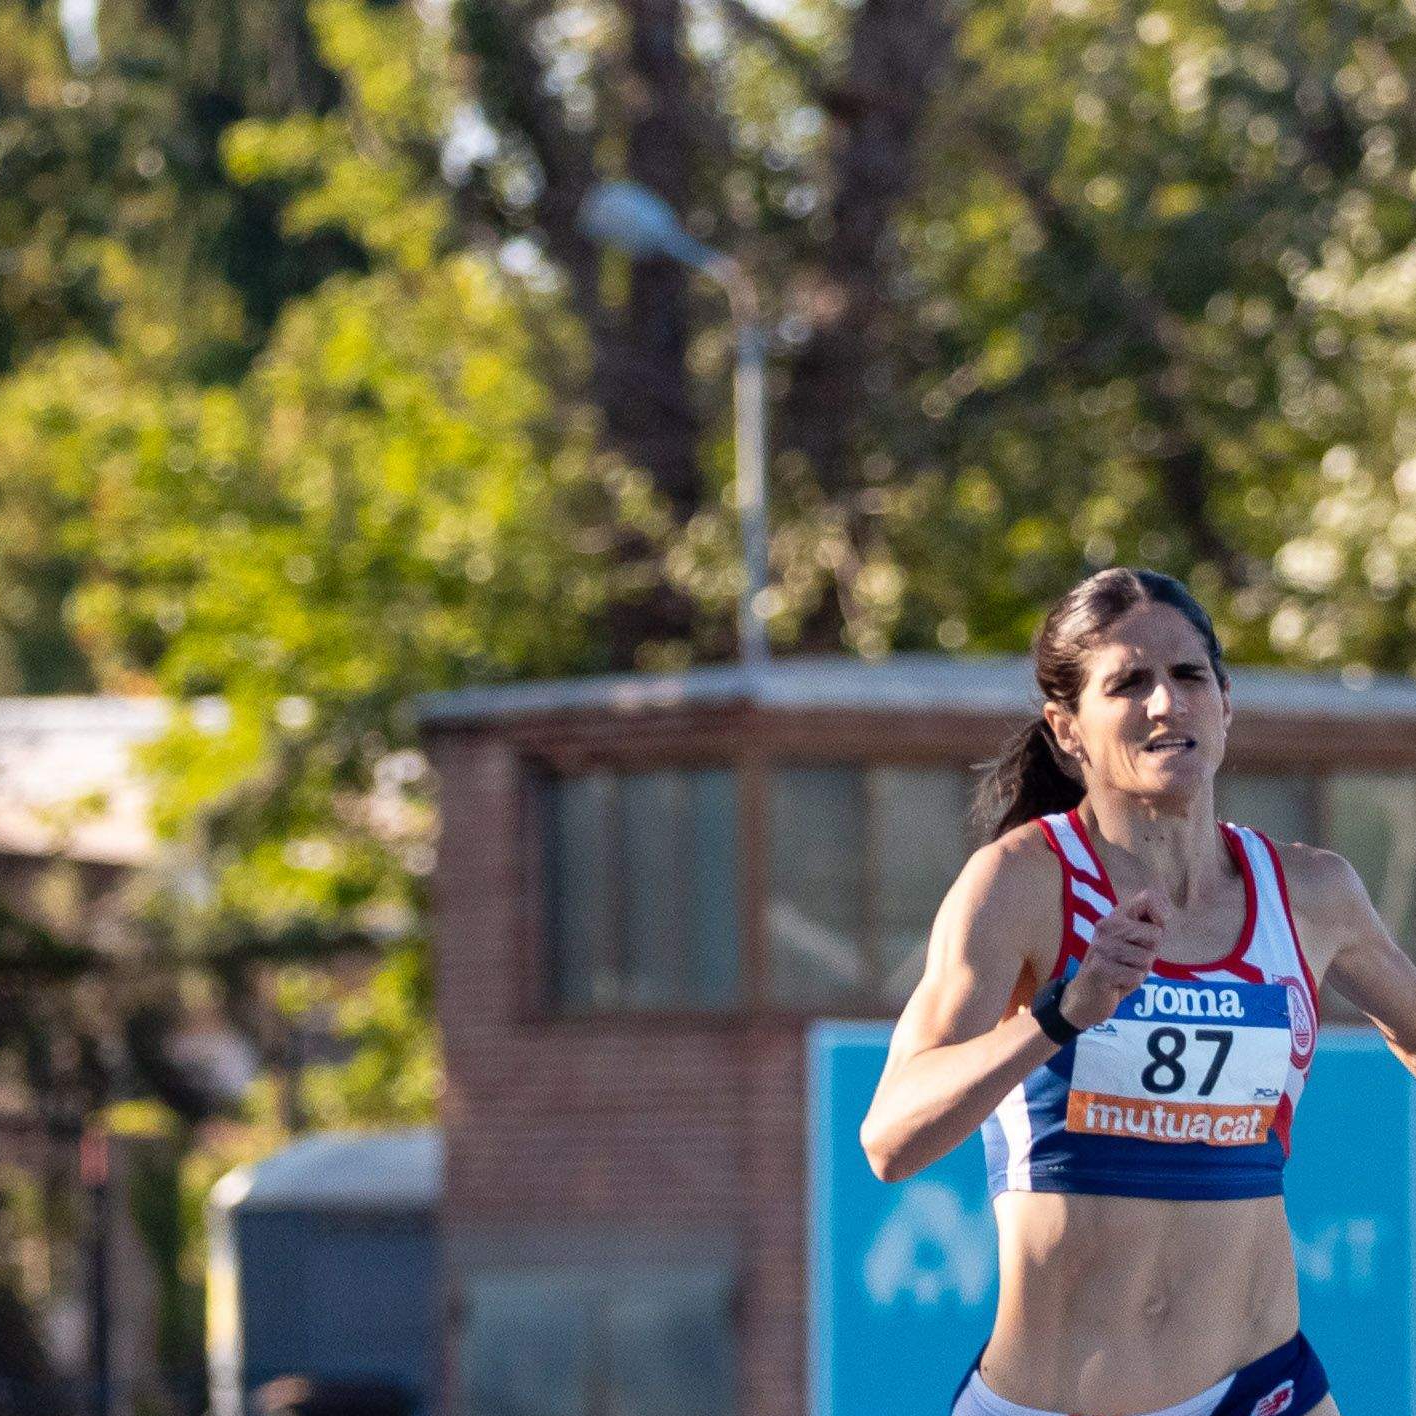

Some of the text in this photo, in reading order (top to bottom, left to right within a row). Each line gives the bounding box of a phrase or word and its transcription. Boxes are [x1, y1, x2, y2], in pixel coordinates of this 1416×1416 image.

[1133, 983, 1245, 1018] Joma
[1140, 1026, 1234, 1097] 87
[1085, 1102, 1262, 1142] mutuacat
